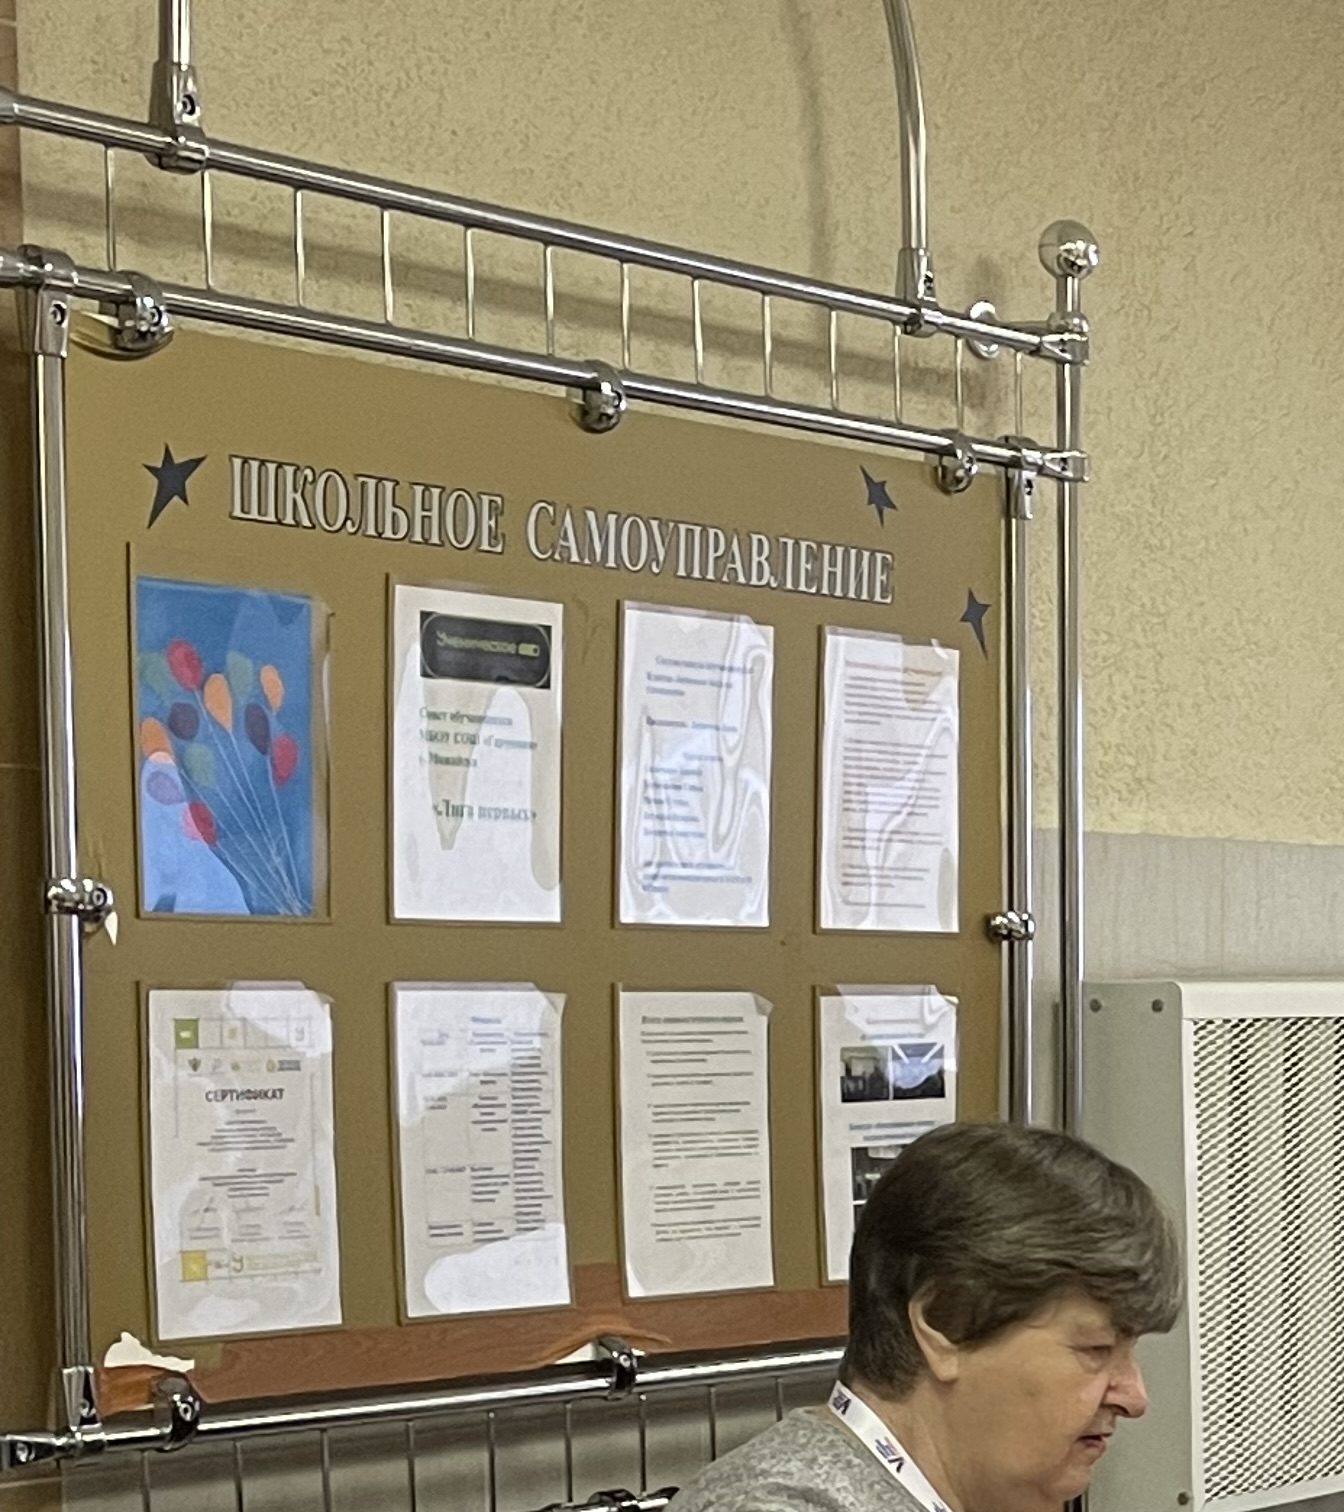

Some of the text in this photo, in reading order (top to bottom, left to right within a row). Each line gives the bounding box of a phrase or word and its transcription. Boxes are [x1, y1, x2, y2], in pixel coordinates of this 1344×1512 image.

[229, 453, 895, 605] ШКОЛЬНОЕ САМОУПРАВЛЕНИЕ
[205, 1087, 285, 1102] СЕРТИФИКАТ
